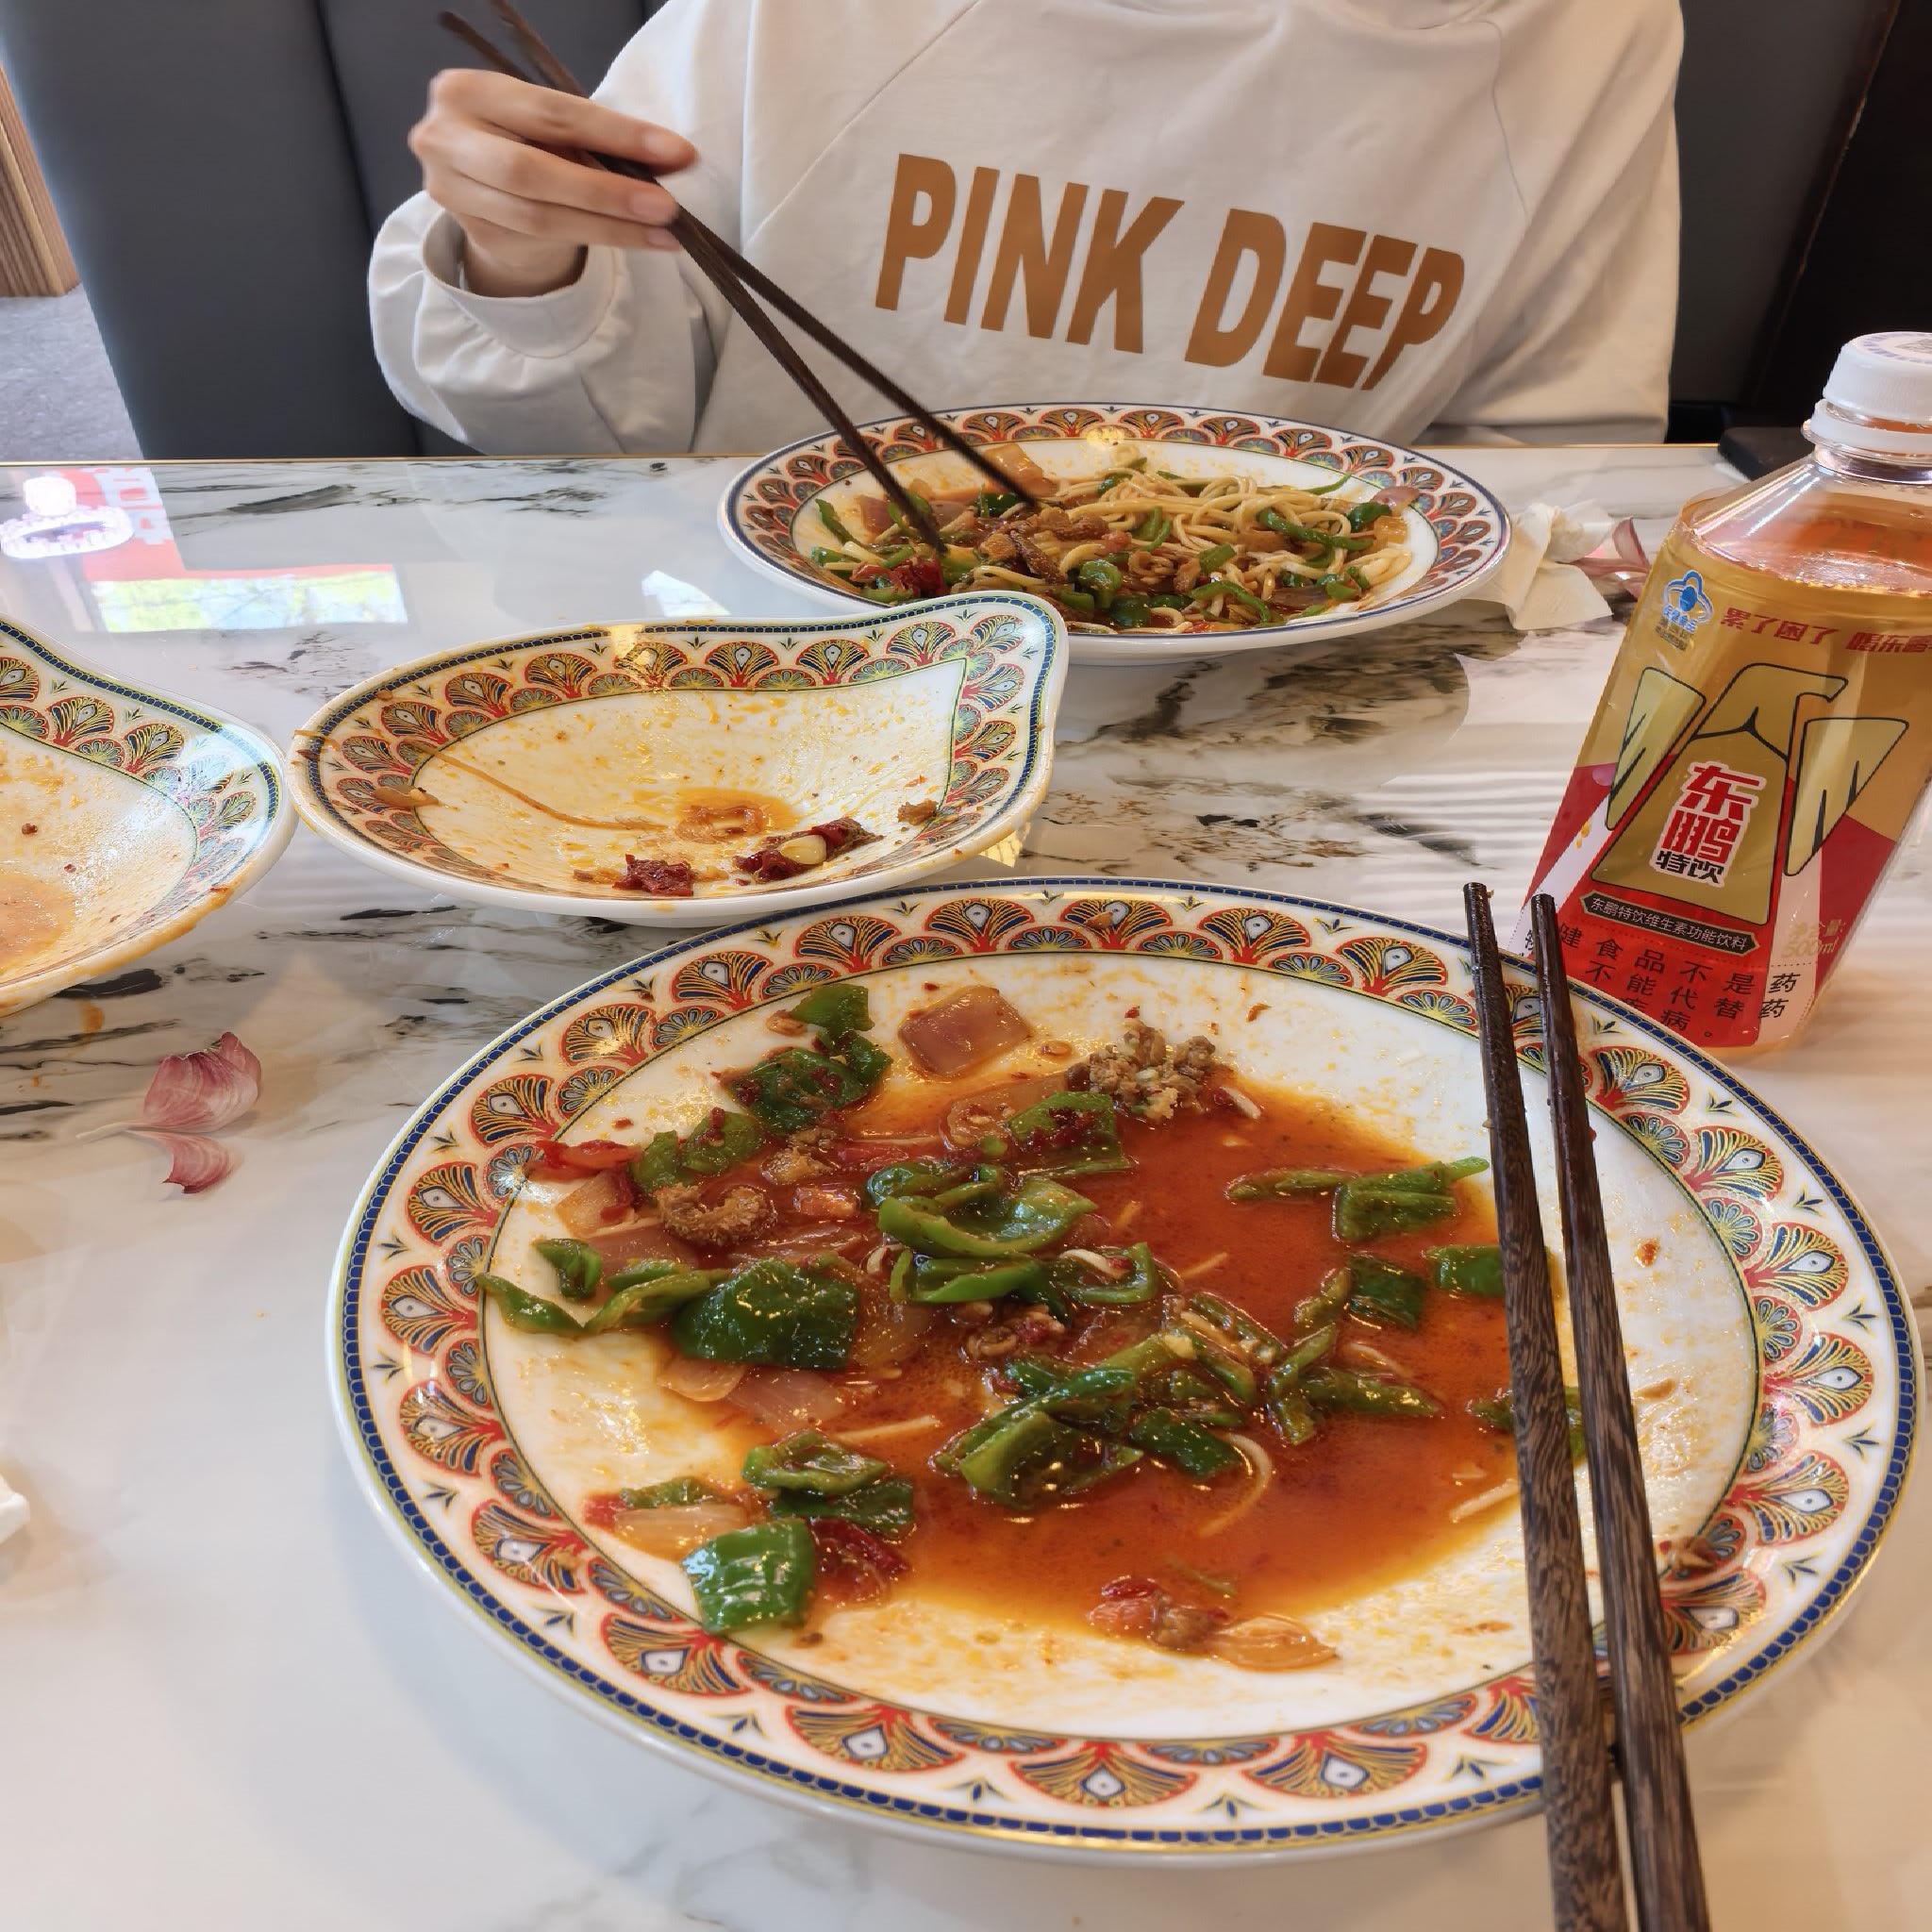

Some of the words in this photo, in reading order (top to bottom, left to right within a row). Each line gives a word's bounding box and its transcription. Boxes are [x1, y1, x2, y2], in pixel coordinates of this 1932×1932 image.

[875, 153, 1185, 354] PINK
[1184, 208, 1465, 391] DEEP
[1721, 607, 1839, 644] 累了困了
[1845, 631, 1932, 653] 喝东鹏
[1660, 765, 1760, 864] 东鹏
[1656, 850, 1724, 884] 特饮
[1591, 896, 1748, 951] 东鹏特饮维生素功能饮料
